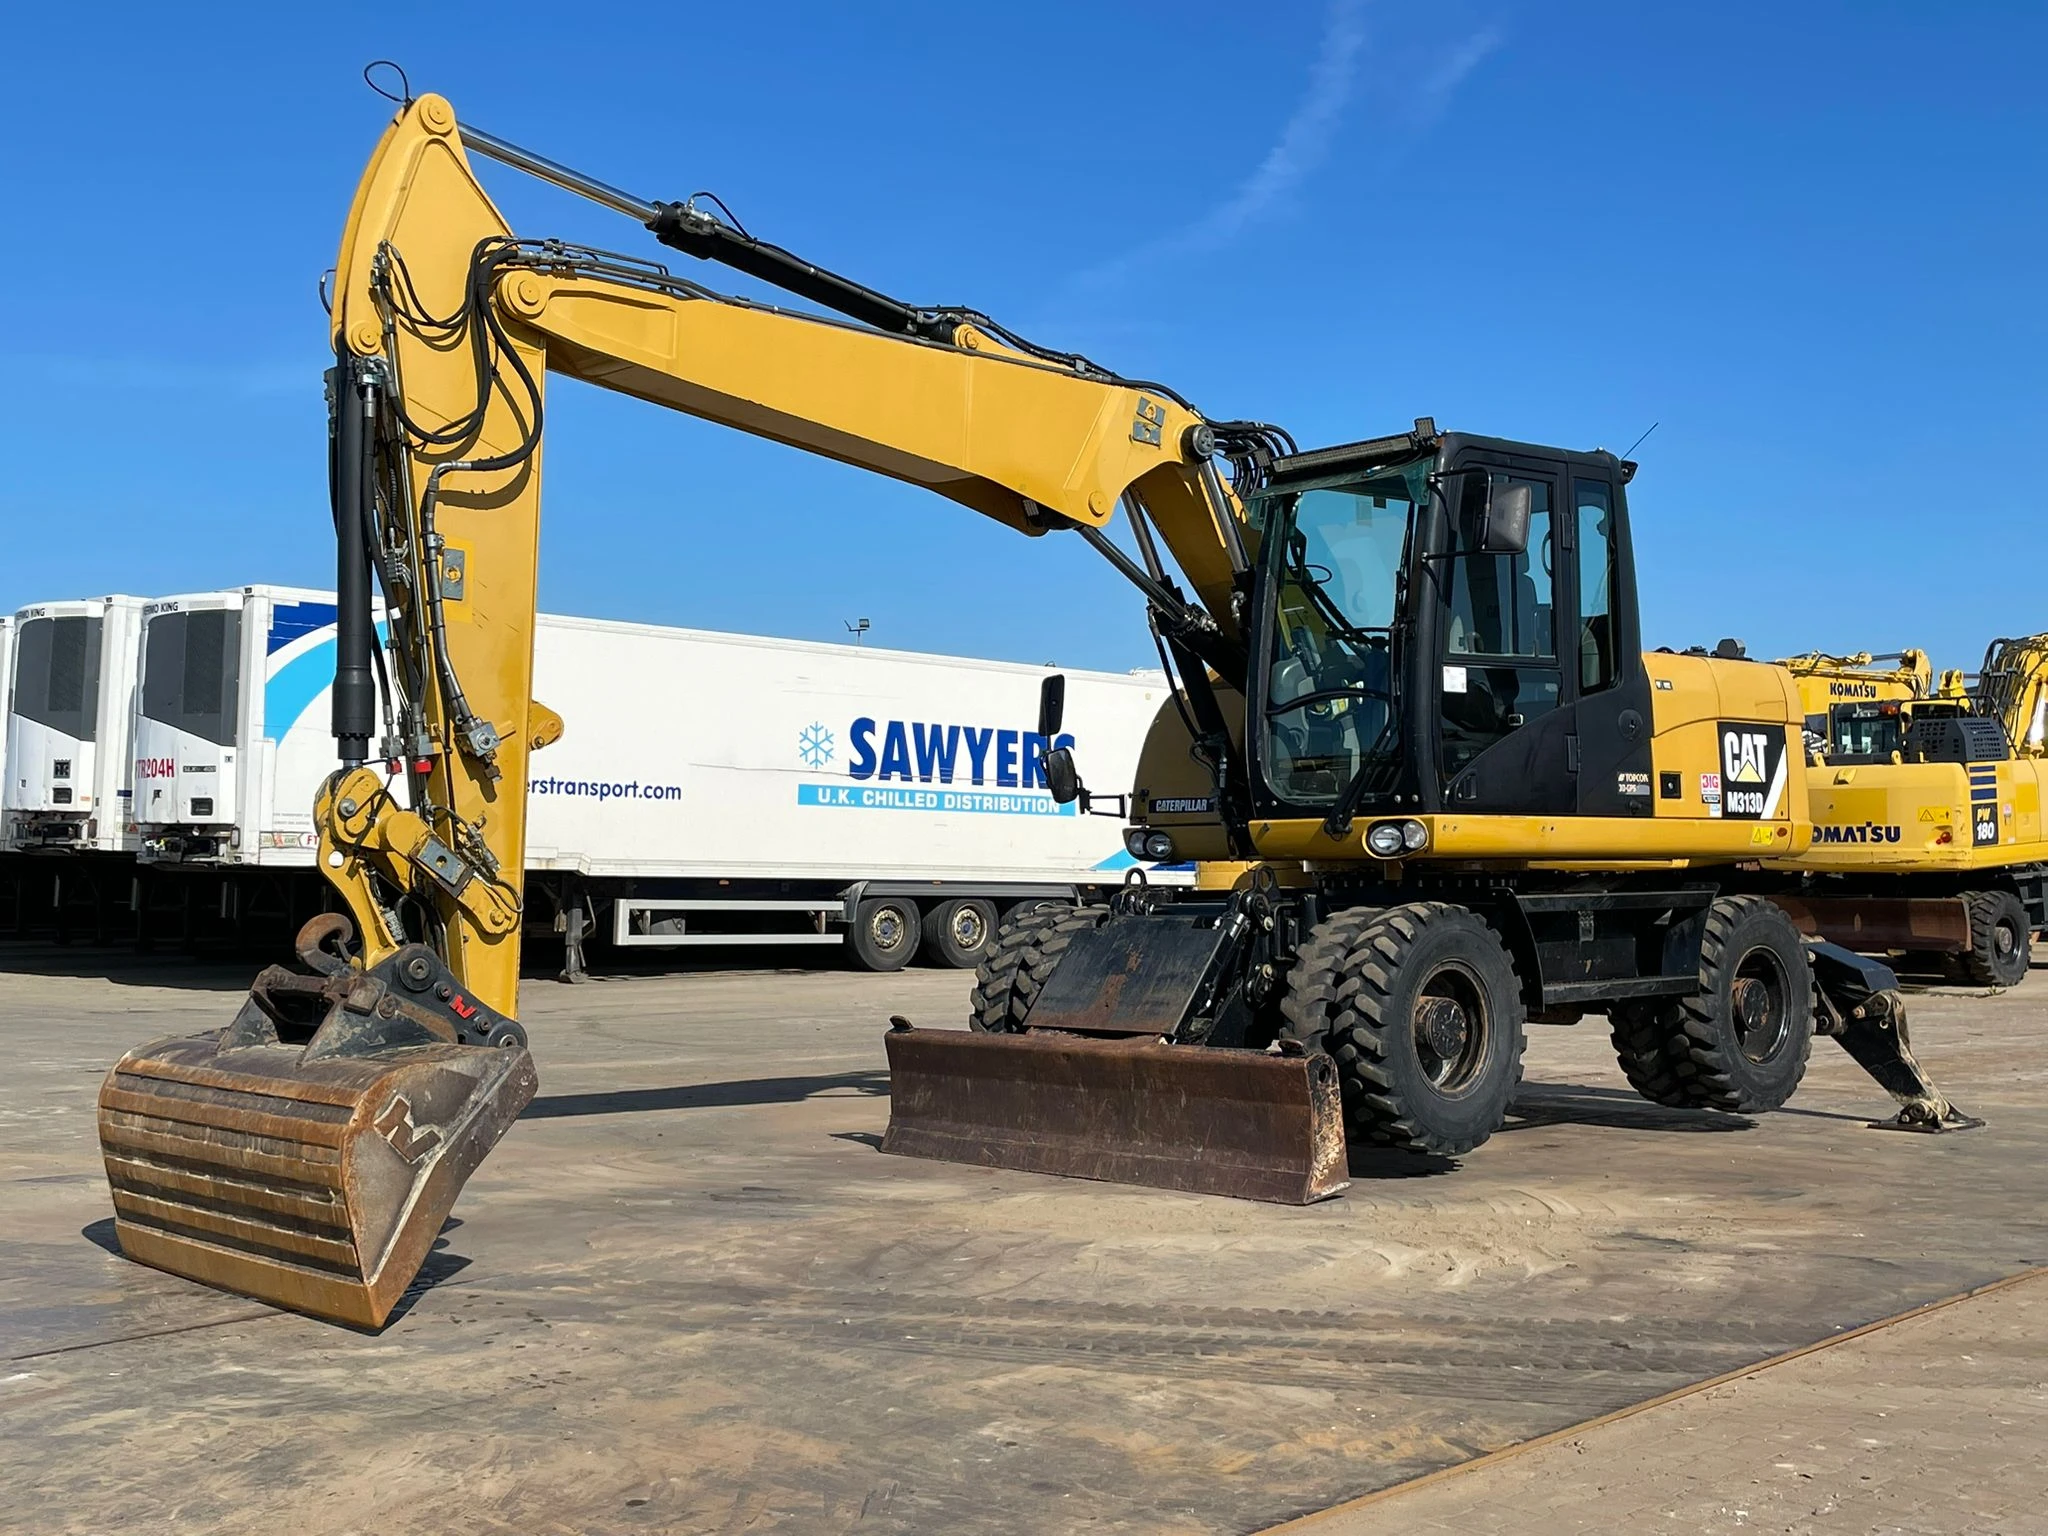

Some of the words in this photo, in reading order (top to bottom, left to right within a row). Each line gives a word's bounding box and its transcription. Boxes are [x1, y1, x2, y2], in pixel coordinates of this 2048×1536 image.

[1830, 681, 1876, 698] KOMATSU
[1724, 731, 1767, 783] CAT
[136, 758, 175, 778] TR204H
[818, 788, 855, 805] U.K.
[863, 790, 938, 808] CHILLED
[944, 793, 1060, 814] DISTRIBUTION
[1156, 799, 1208, 812] CATERPILLAR
[1727, 791, 1764, 814] M313D
[1977, 808, 1991, 822] PW
[1812, 822, 1901, 843] OMATSU
[1977, 822, 1995, 840] 180
